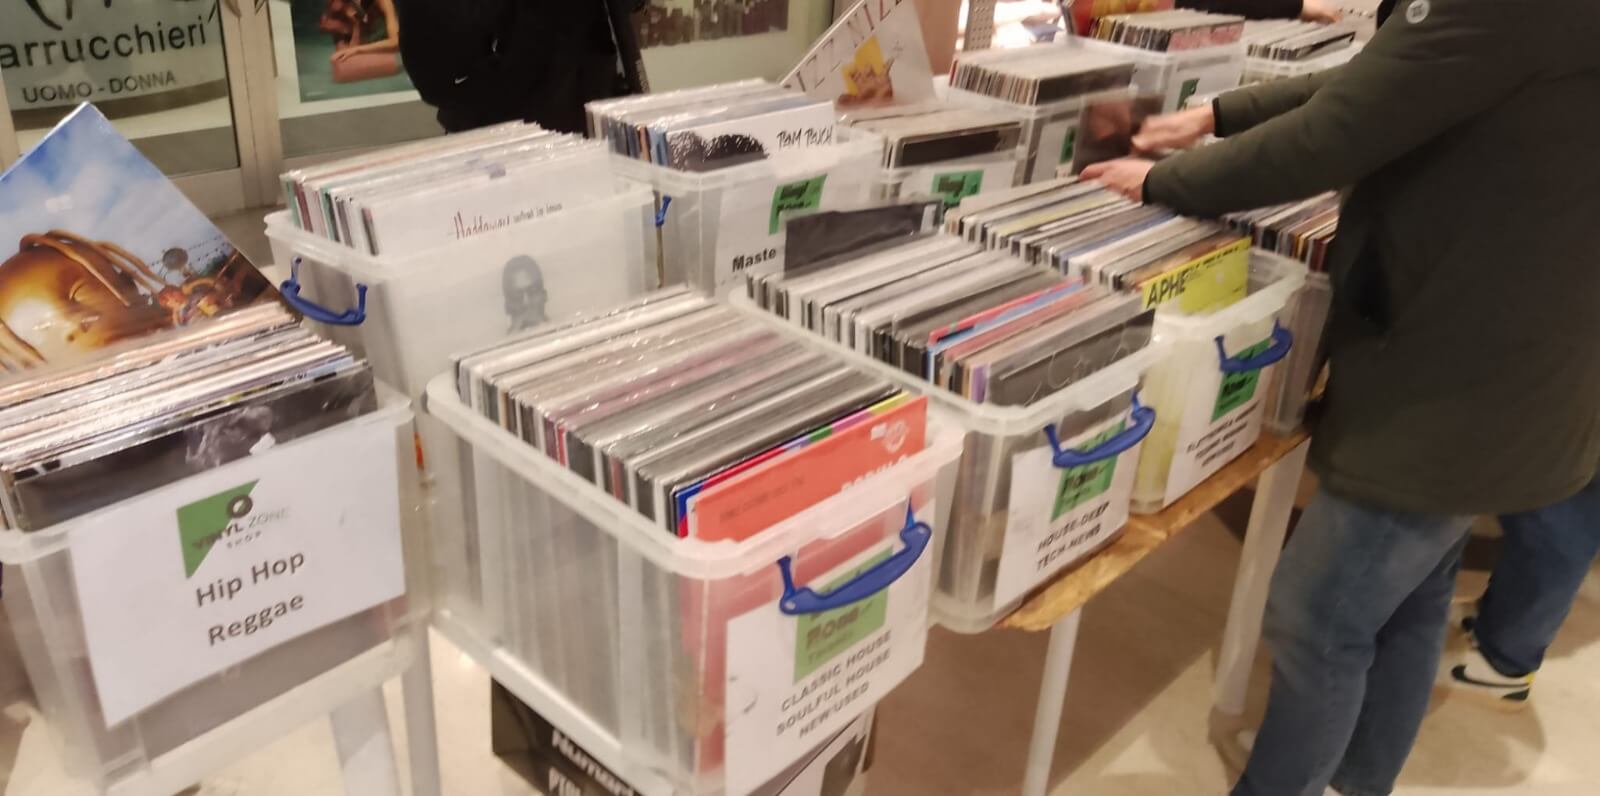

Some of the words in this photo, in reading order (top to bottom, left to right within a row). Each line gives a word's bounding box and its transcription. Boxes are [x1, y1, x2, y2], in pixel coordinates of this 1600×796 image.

[0, 15, 206, 69] arrucchieri
[22, 81, 92, 104] UOMO
[109, 69, 177, 95] DONNA
[196, 577, 242, 607] Hip
[252, 552, 304, 584] Hop
[208, 595, 304, 646] Reggae
[776, 683, 841, 737] SOULFUL
[845, 648, 891, 688] HOUSE
[781, 663, 841, 712] CLASSIC
[846, 629, 892, 669] HOUSE
